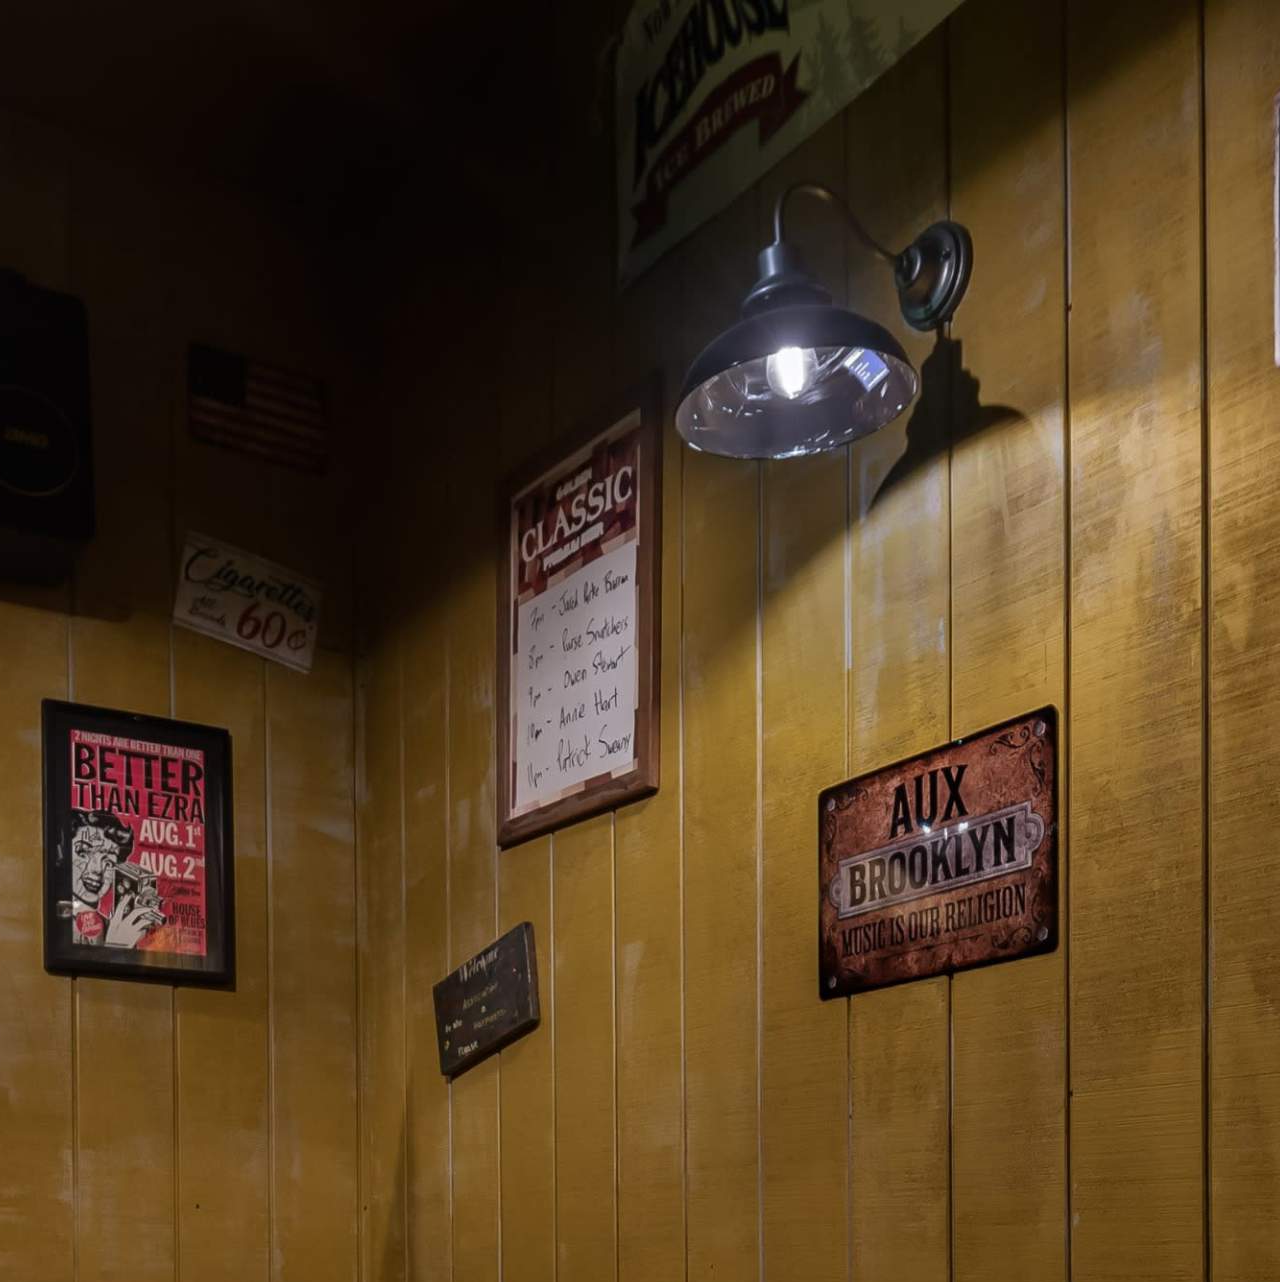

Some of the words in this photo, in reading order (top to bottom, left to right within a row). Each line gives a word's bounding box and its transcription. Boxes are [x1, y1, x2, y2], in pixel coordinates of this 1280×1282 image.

[521, 466, 633, 562] CLASSIC
[594, 686, 619, 716] Hart
[73, 743, 204, 796] BETTER
[75, 782, 141, 815] THAN
[147, 791, 205, 825] EZRA
[888, 764, 969, 840] AUX
[139, 818, 183, 847] AUG.
[139, 851, 182, 878] AUG.
[849, 815, 1016, 907] BROOKLYN
[841, 919, 887, 958] MUSIC
[890, 914, 905, 946] IS
[908, 905, 940, 942] OUR
[945, 882, 1027, 933] RELIGION
